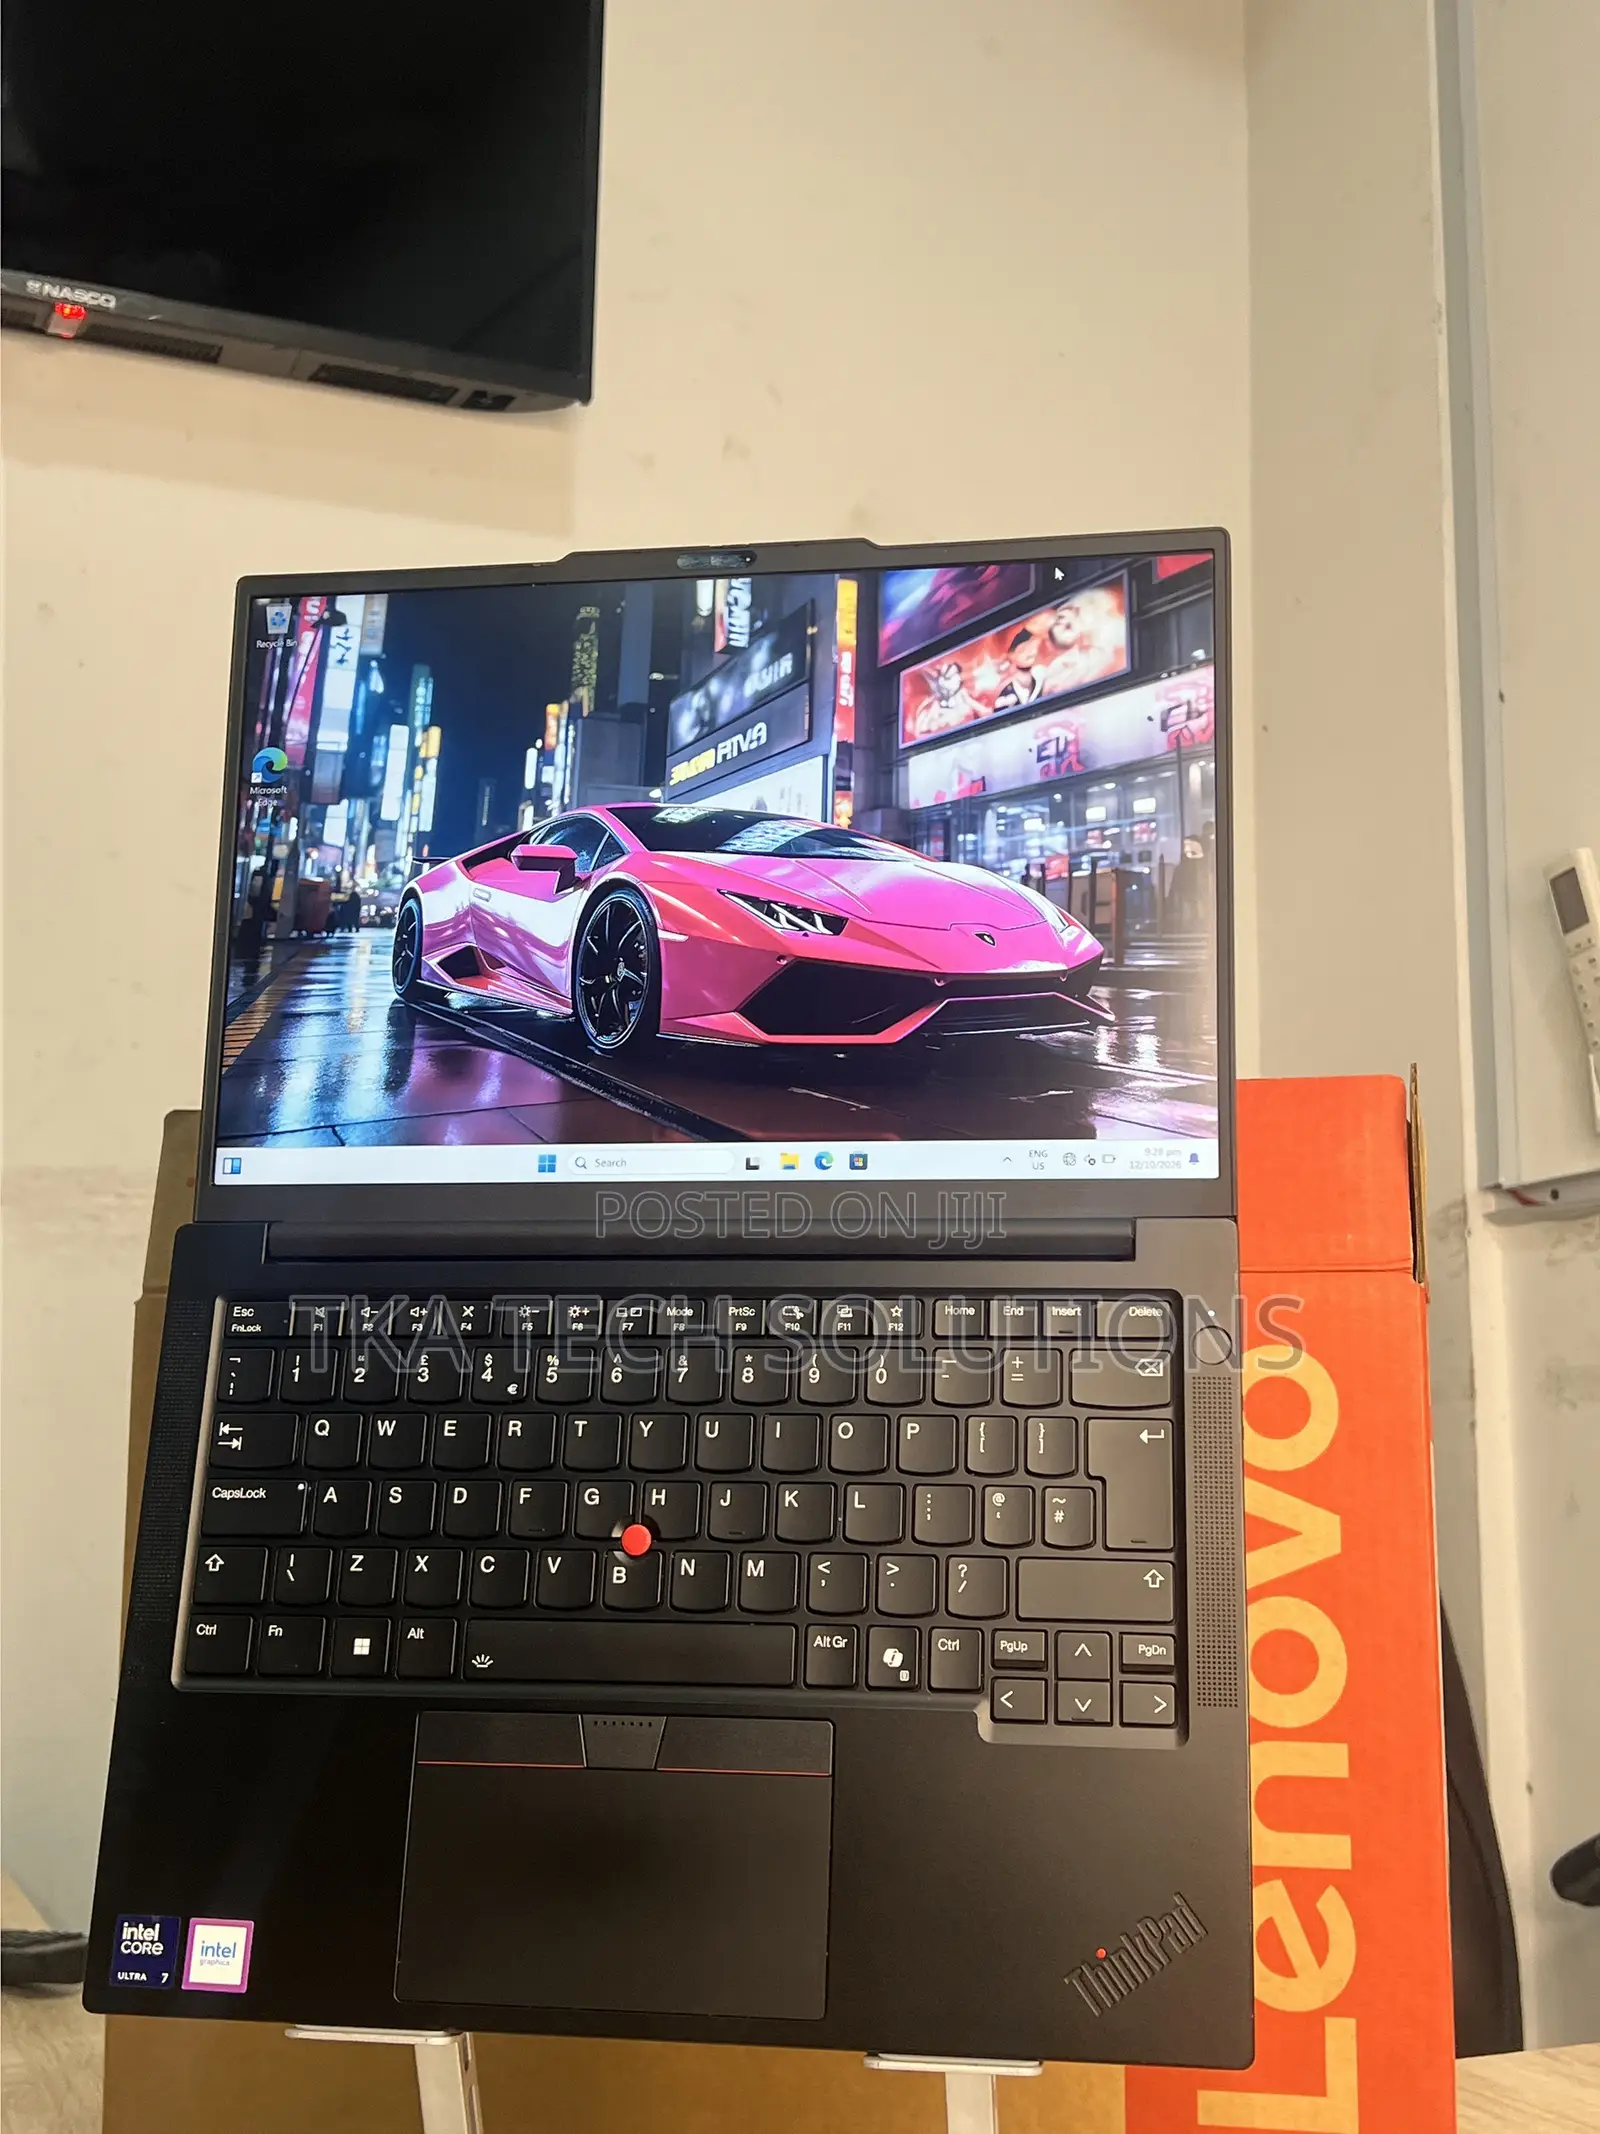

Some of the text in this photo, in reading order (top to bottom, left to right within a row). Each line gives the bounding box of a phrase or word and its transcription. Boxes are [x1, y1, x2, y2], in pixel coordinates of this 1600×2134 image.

[256, 638, 297, 649] Recycle Bin
[250, 786, 287, 795] Microsoft
[257, 798, 278, 807] Edge
[595, 1157, 627, 1168] Search
[1029, 1150, 1048, 1159] ENG
[1032, 1162, 1045, 1171] US
[233, 1306, 254, 1317] Esc
[666, 1306, 693, 1316] Mode
[728, 1306, 755, 1317] PrtSc
[945, 1306, 975, 1316] Home
[1003, 1306, 1024, 1316] End
[1052, 1306, 1081, 1316] Insert
[1129, 1306, 1163, 1316] Delete
[231, 1324, 261, 1333] FnLock
[313, 1323, 323, 1332] F1
[362, 1323, 373, 1332] F2
[412, 1323, 423, 1332] F3
[461, 1323, 472, 1331] F4
[522, 1323, 533, 1331] F5
[572, 1323, 583, 1331] F6
[622, 1323, 634, 1331] F7
[673, 1323, 685, 1331] F8
[736, 1323, 747, 1331] F9
[785, 1323, 800, 1331] F10
[837, 1323, 851, 1331] F11
[888, 1323, 903, 1331] F12
[292, 1367, 300, 1383] 1
[354, 1367, 365, 1383] 2
[417, 1367, 429, 1383] 3
[481, 1367, 493, 1383] 4
[546, 1367, 558, 1383] 5
[611, 1367, 623, 1383] 6
[677, 1367, 688, 1383] 7
[742, 1367, 754, 1383] 8
[808, 1367, 820, 1383] 9
[876, 1367, 887, 1383] 0
[507, 1384, 518, 1394] €
[314, 1420, 330, 1436] Q
[377, 1420, 396, 1436] W
[444, 1420, 457, 1436] E
[508, 1421, 522, 1437] R
[574, 1421, 588, 1437] T
[639, 1421, 653, 1437] Y
[705, 1421, 719, 1437] U
[775, 1422, 780, 1438] I
[838, 1422, 854, 1439] O
[907, 1423, 920, 1440] P
[212, 1487, 266, 1500] CapsLock
[323, 1486, 338, 1503] A
[388, 1486, 402, 1504] S
[453, 1487, 468, 1504] D
[519, 1488, 532, 1504] F
[584, 1488, 600, 1505] G
[651, 1488, 666, 1506] H
[720, 1489, 731, 1507] J
[785, 1490, 799, 1508] K
[854, 1491, 866, 1509] L
[992, 1493, 1005, 1506] @
[1054, 1510, 1065, 1523] #
[350, 1555, 364, 1572] Z
[414, 1555, 429, 1572] X
[480, 1556, 495, 1574] C
[547, 1557, 562, 1574] V
[681, 1559, 695, 1576] N
[747, 1560, 764, 1577] M
[958, 1564, 967, 1577] ?
[613, 1567, 627, 1584] B
[196, 1624, 217, 1636] Ctrl
[268, 1625, 283, 1637] Fn
[407, 1628, 425, 1639] Alt
[813, 1635, 848, 1648] Alt Gr
[937, 1639, 960, 1651] Ctrl
[1000, 1641, 1028, 1653] PgUp
[1138, 1645, 1167, 1657] PgDn
[1198, 1344, 1359, 2134] Lenovo
[122, 1922, 160, 1942] intel
[201, 1940, 237, 1959] intel
[1063, 1891, 1209, 2018] ThinkPad
[117, 1972, 169, 1983] ULTRA 7
